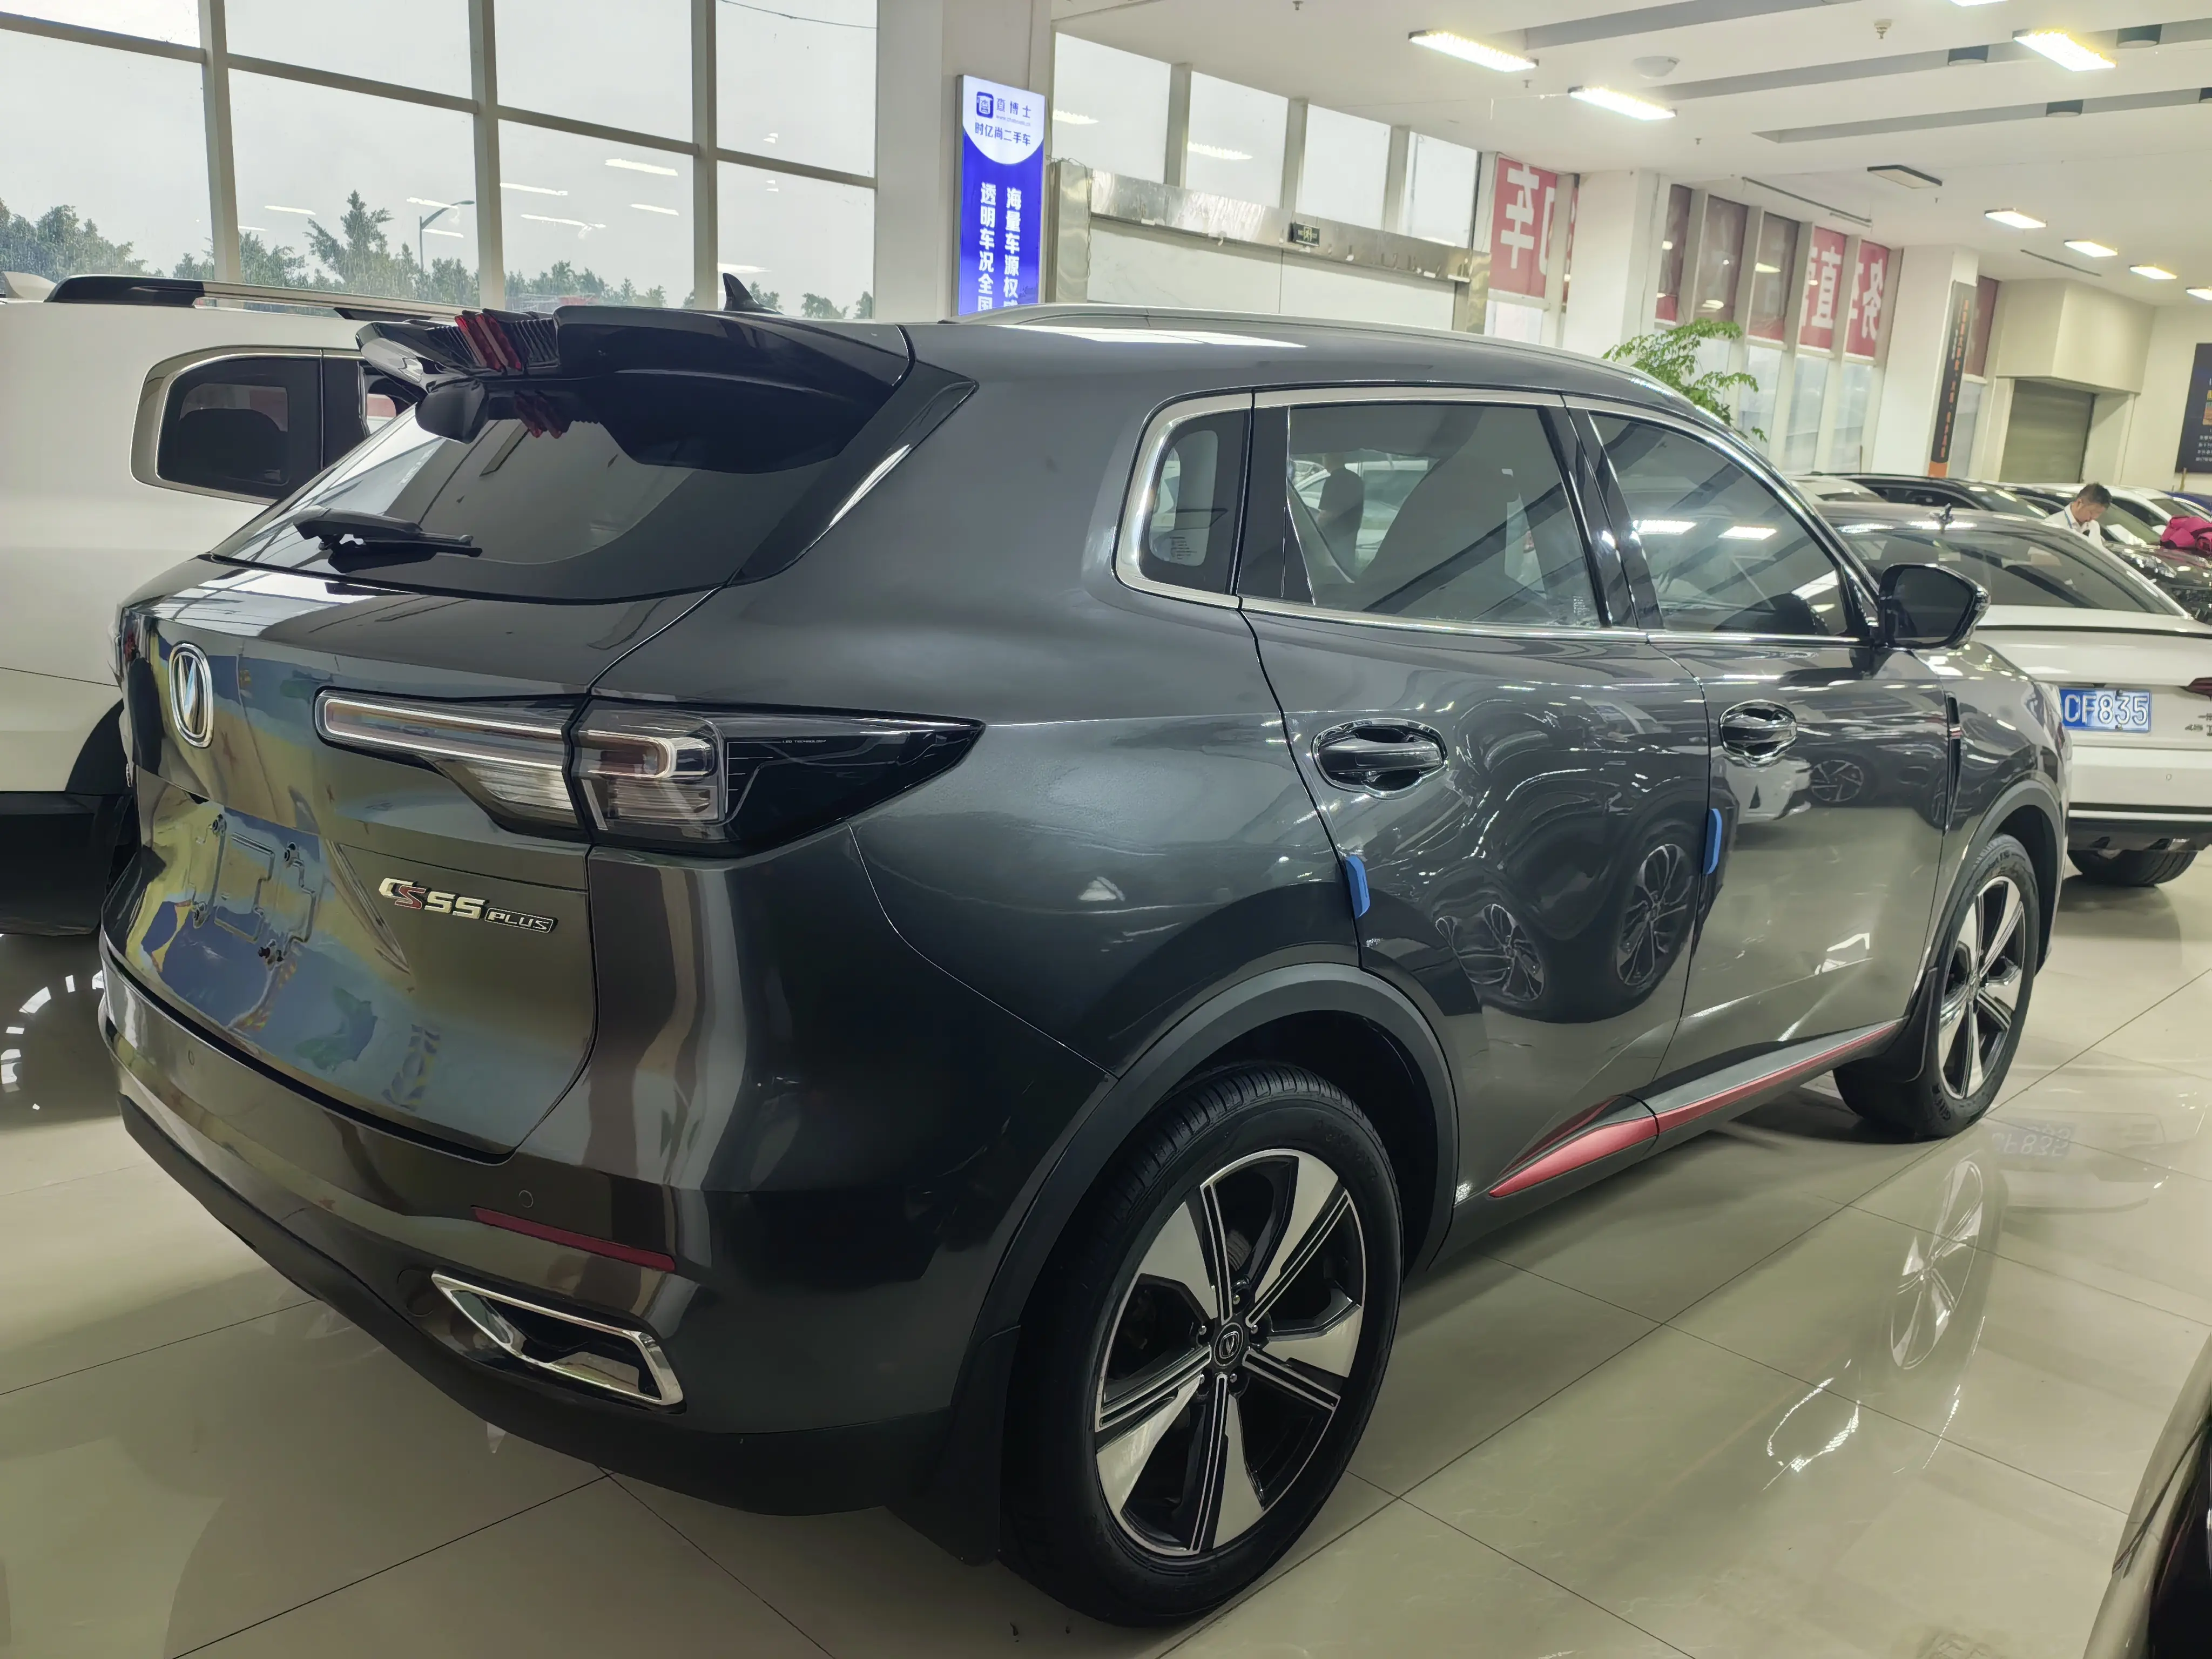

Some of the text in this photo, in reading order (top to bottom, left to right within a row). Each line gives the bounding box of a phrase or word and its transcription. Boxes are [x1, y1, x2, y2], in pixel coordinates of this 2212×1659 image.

[996, 98, 1031, 118] 查博士
[975, 122, 1030, 146] 时亿尚二手车
[2064, 694, 2148, 725] CF835
[487, 911, 550, 930] PLUS
